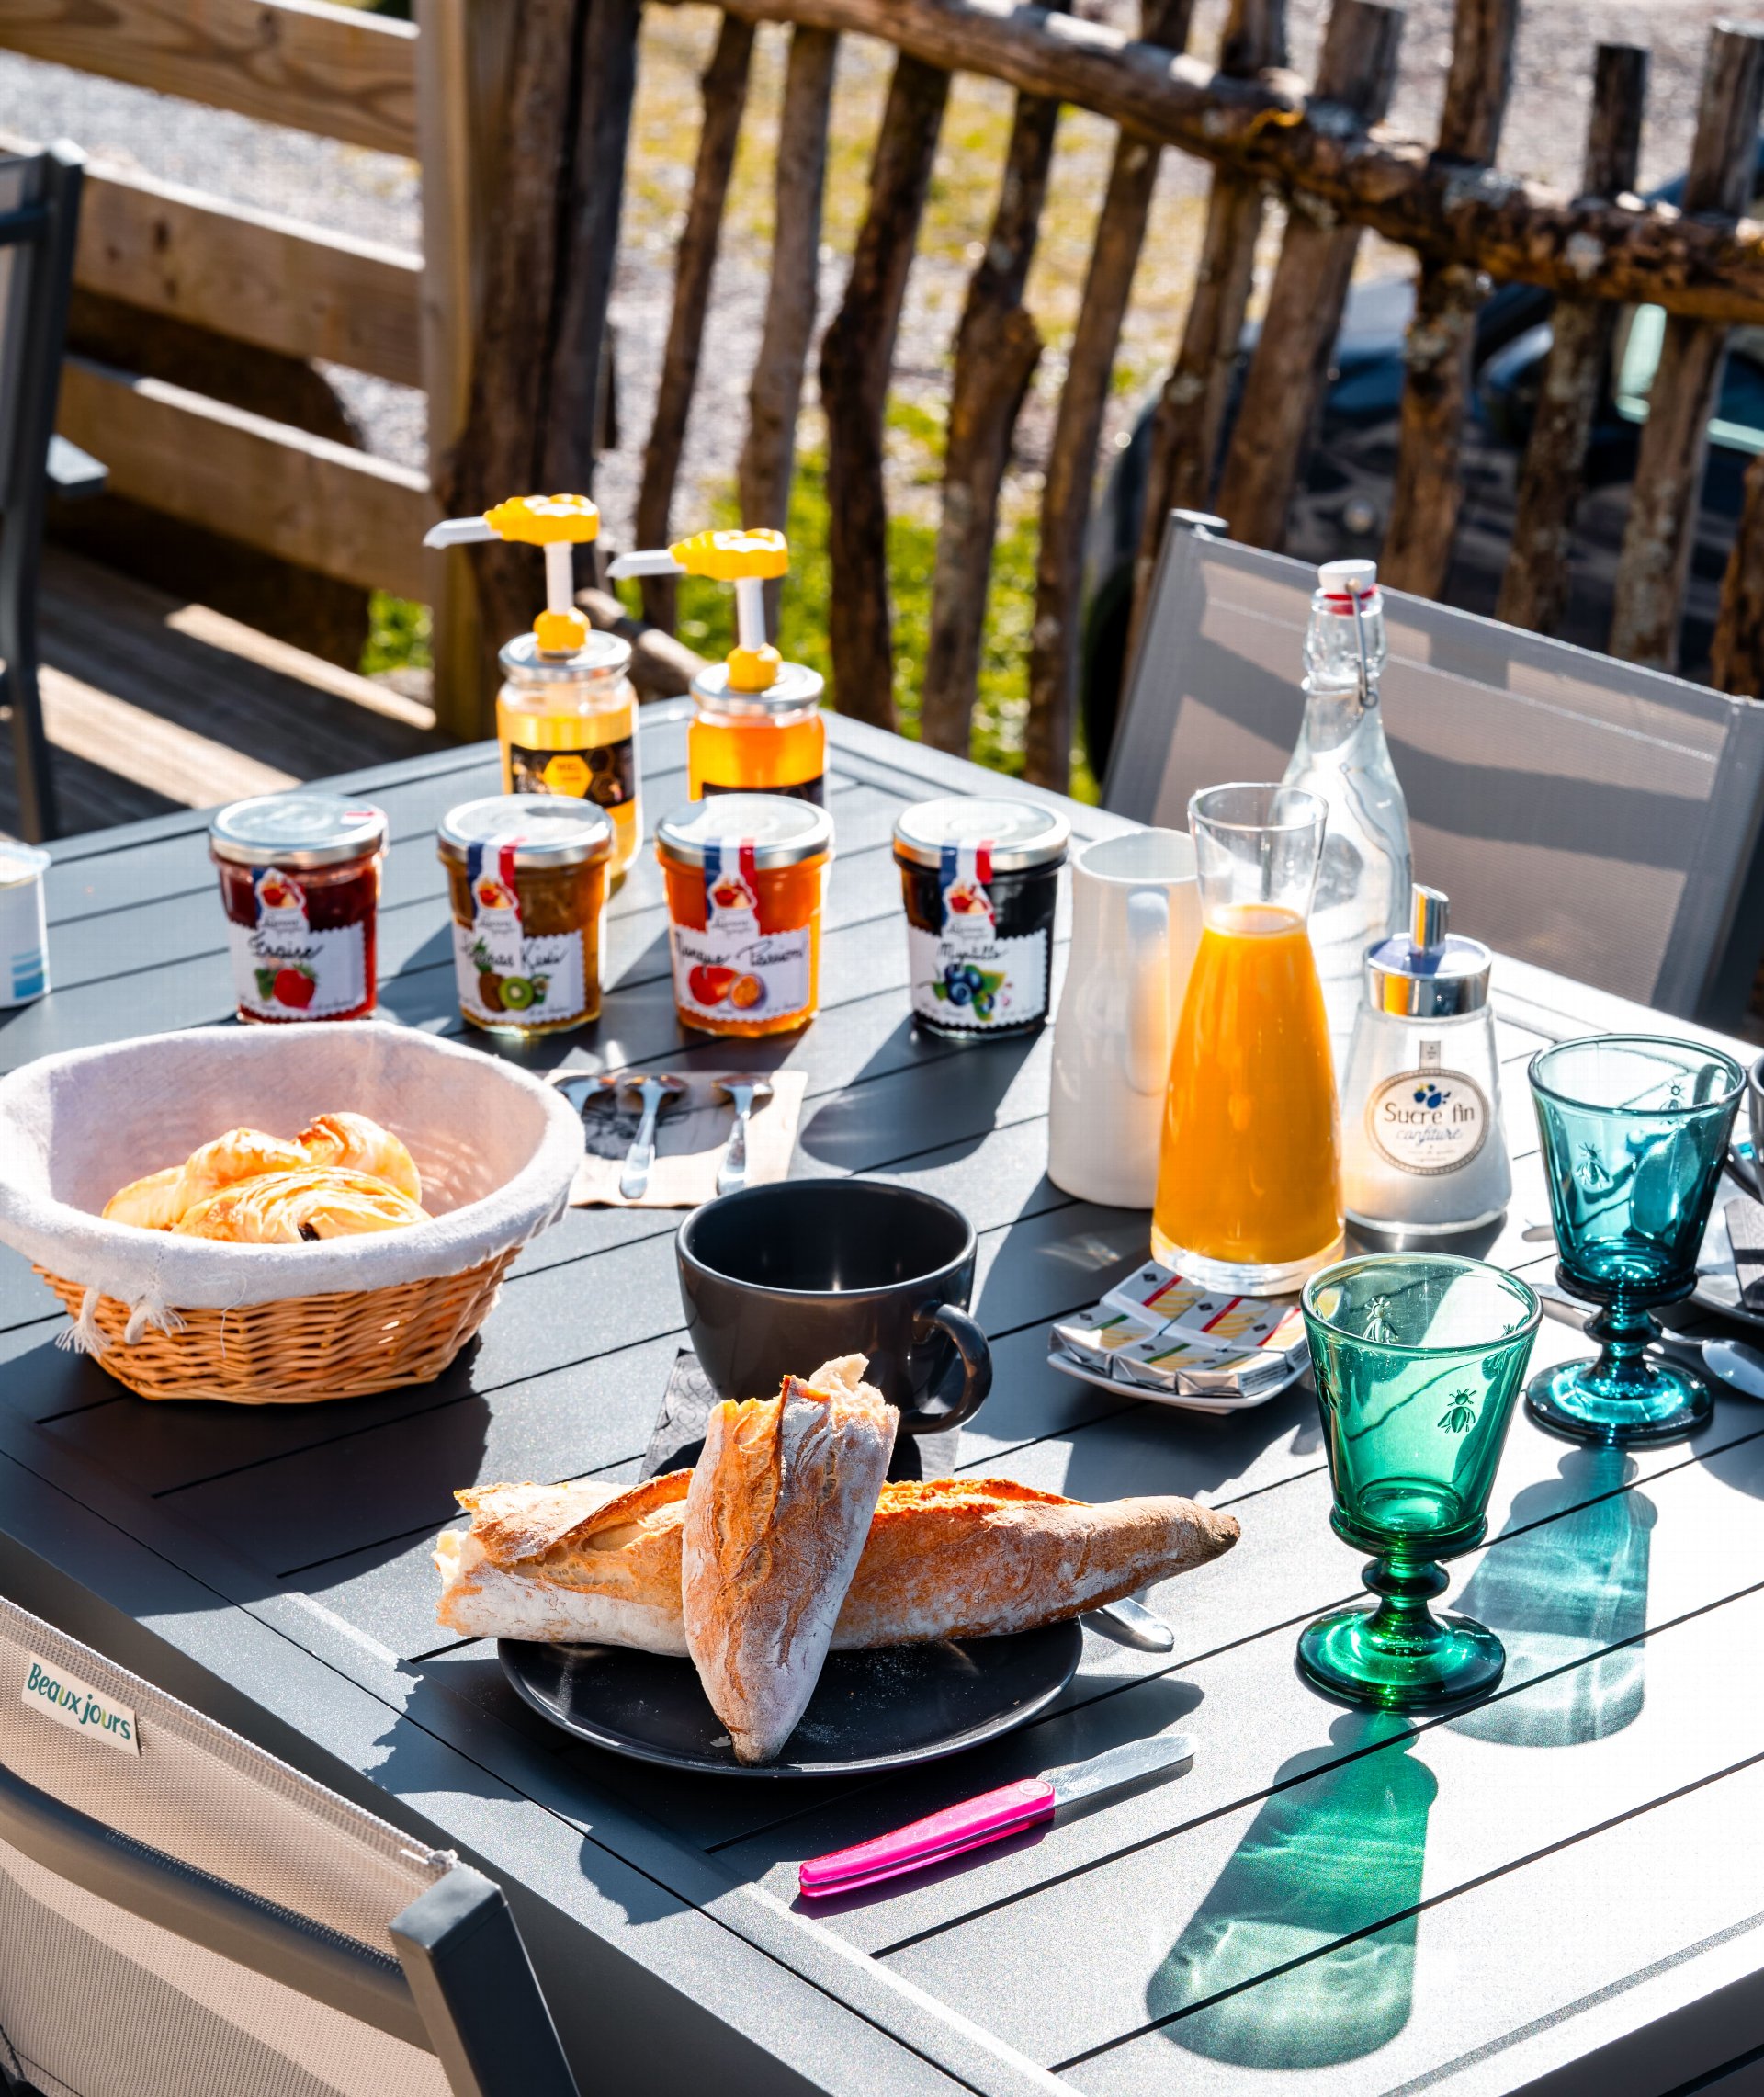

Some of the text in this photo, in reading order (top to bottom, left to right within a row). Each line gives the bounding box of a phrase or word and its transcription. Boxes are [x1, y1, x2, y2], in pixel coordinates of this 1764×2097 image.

[1384, 1102, 1475, 1125] Sucre fin
[27, 1662, 131, 1740] Beaux jours
